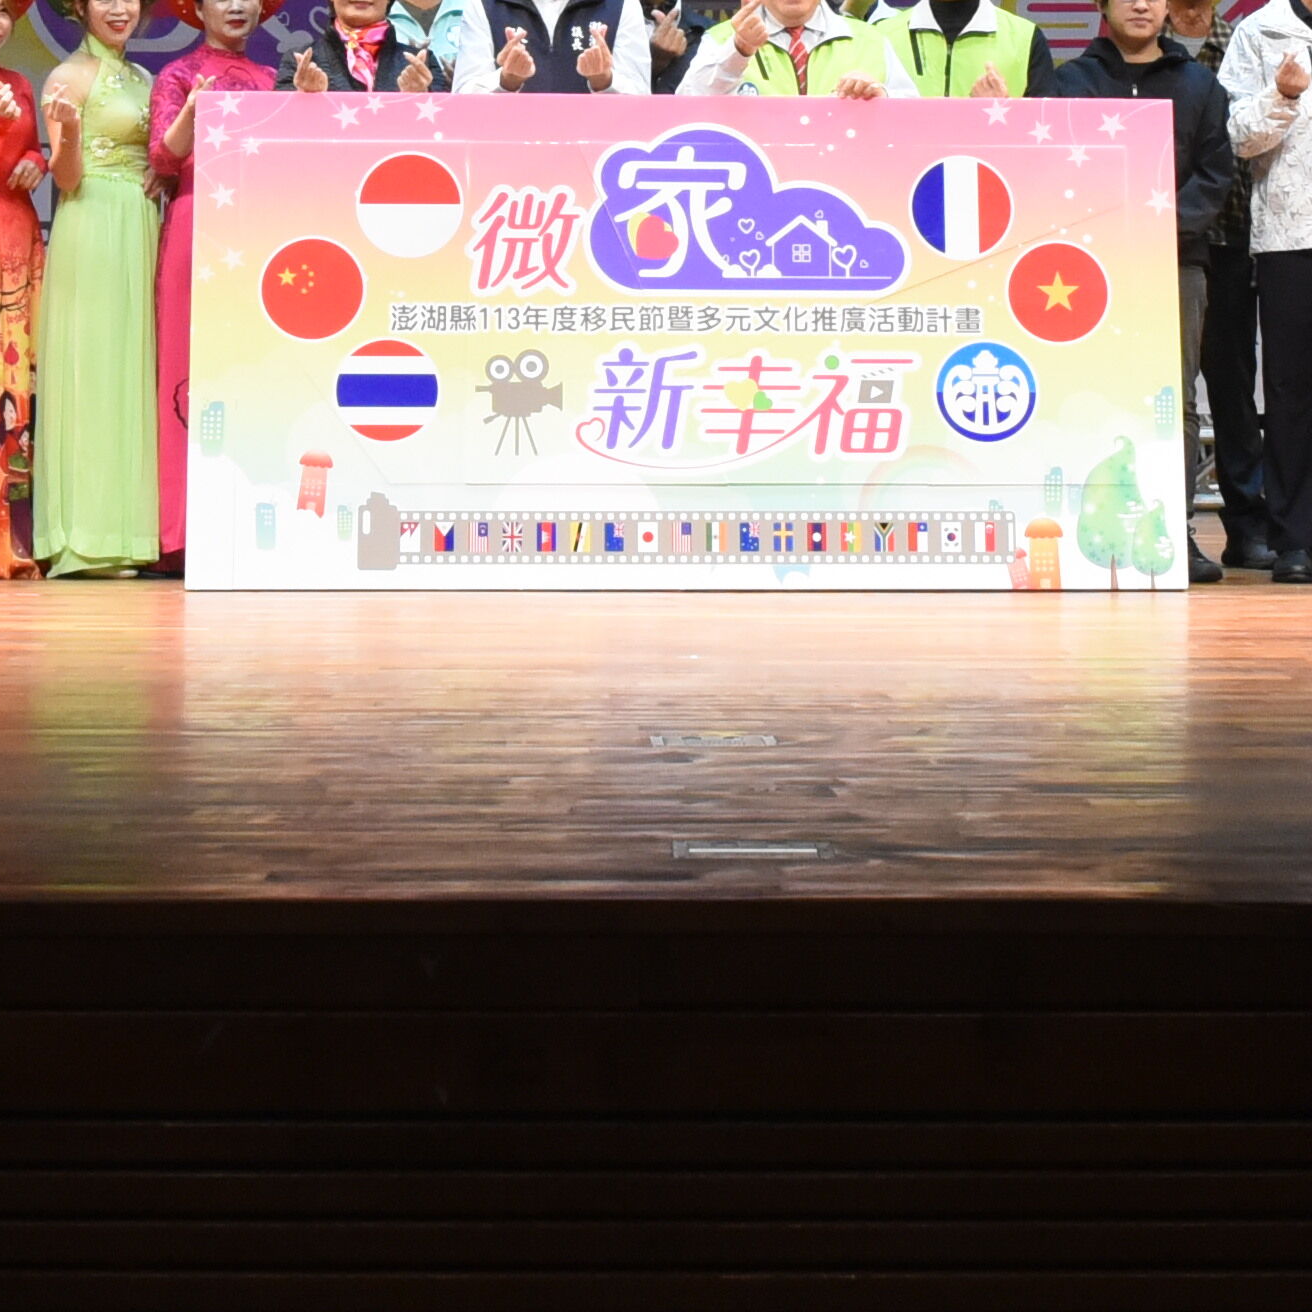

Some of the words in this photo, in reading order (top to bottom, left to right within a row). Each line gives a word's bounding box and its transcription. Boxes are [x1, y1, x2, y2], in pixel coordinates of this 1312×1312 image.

[390, 304, 982, 334] 澎湖縣113年度移民節暨多元文化推廣活動計畫
[593, 347, 914, 456] 新幸福
